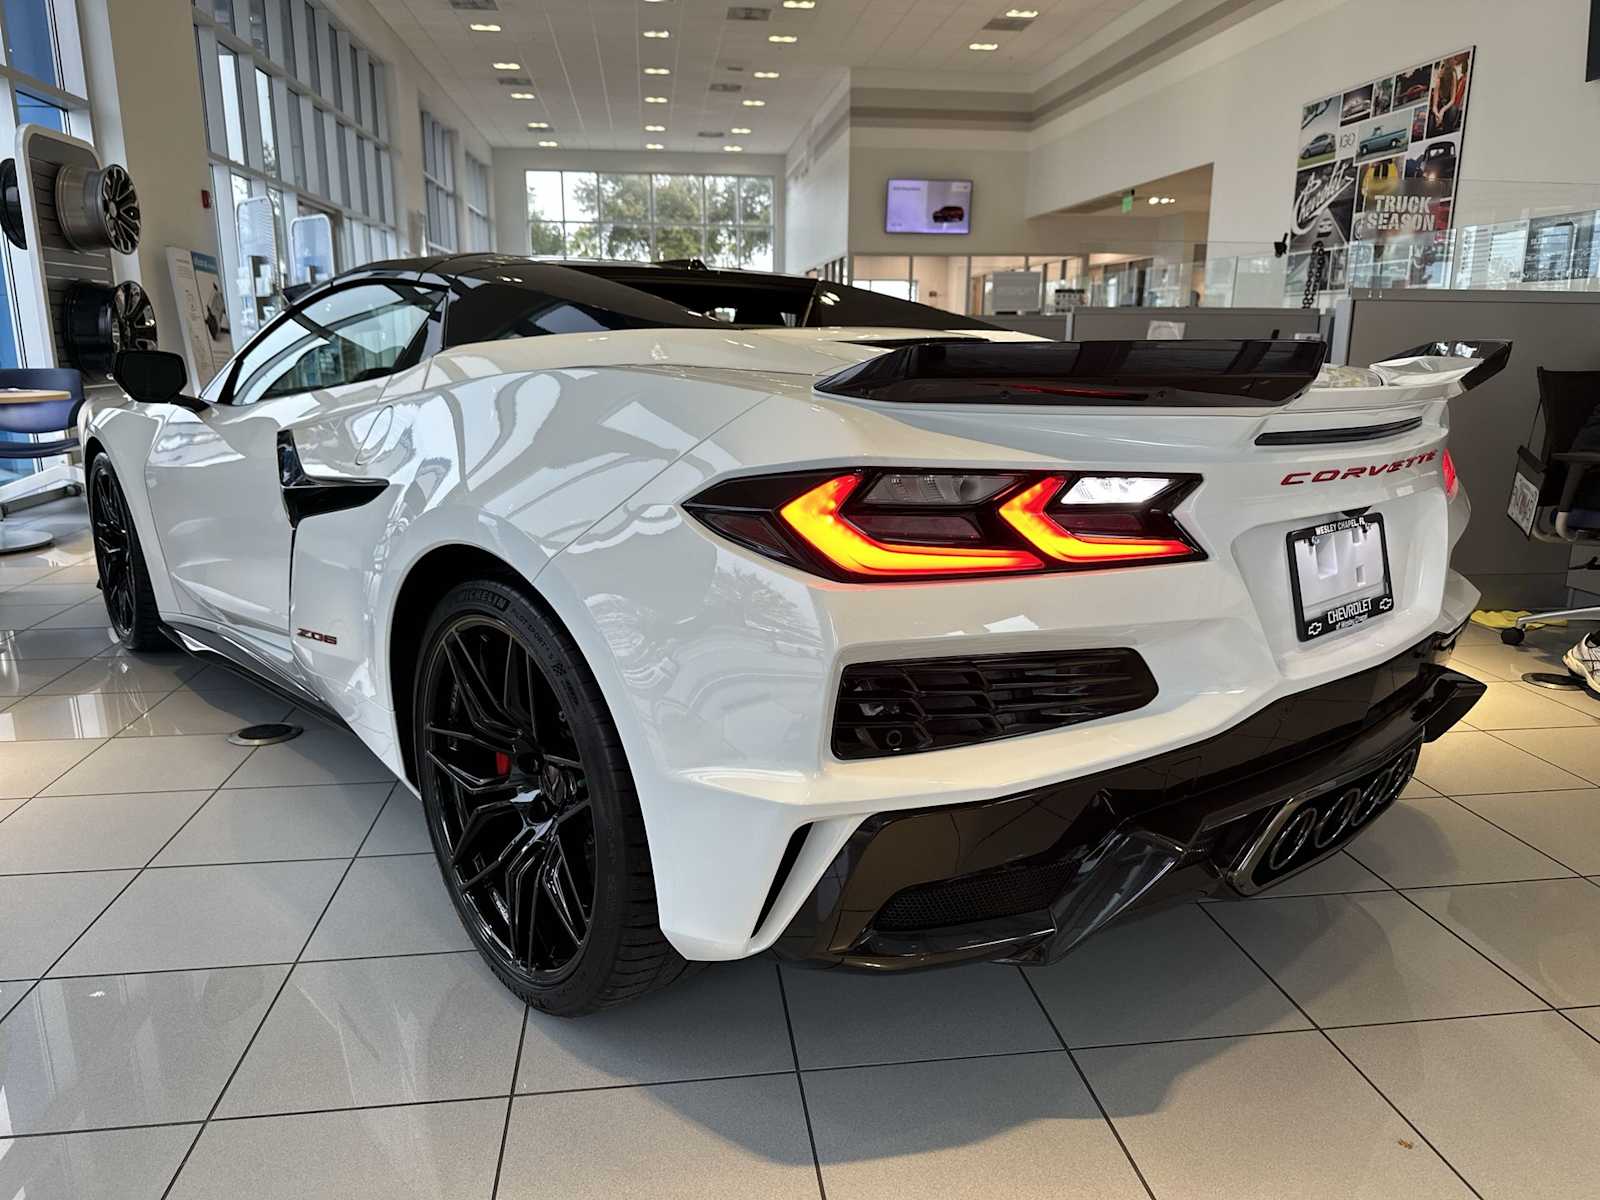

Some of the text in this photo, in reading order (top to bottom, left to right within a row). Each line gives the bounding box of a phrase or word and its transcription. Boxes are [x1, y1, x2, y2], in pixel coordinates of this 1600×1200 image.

[1374, 195, 1432, 214] TRUCK
[1366, 213, 1435, 231] SEASON
[1280, 449, 1438, 486] CORVETTE
[1315, 523, 1337, 536] WESLEY
[1327, 598, 1372, 625] CHEVROLET
[297, 628, 337, 645] Z06
